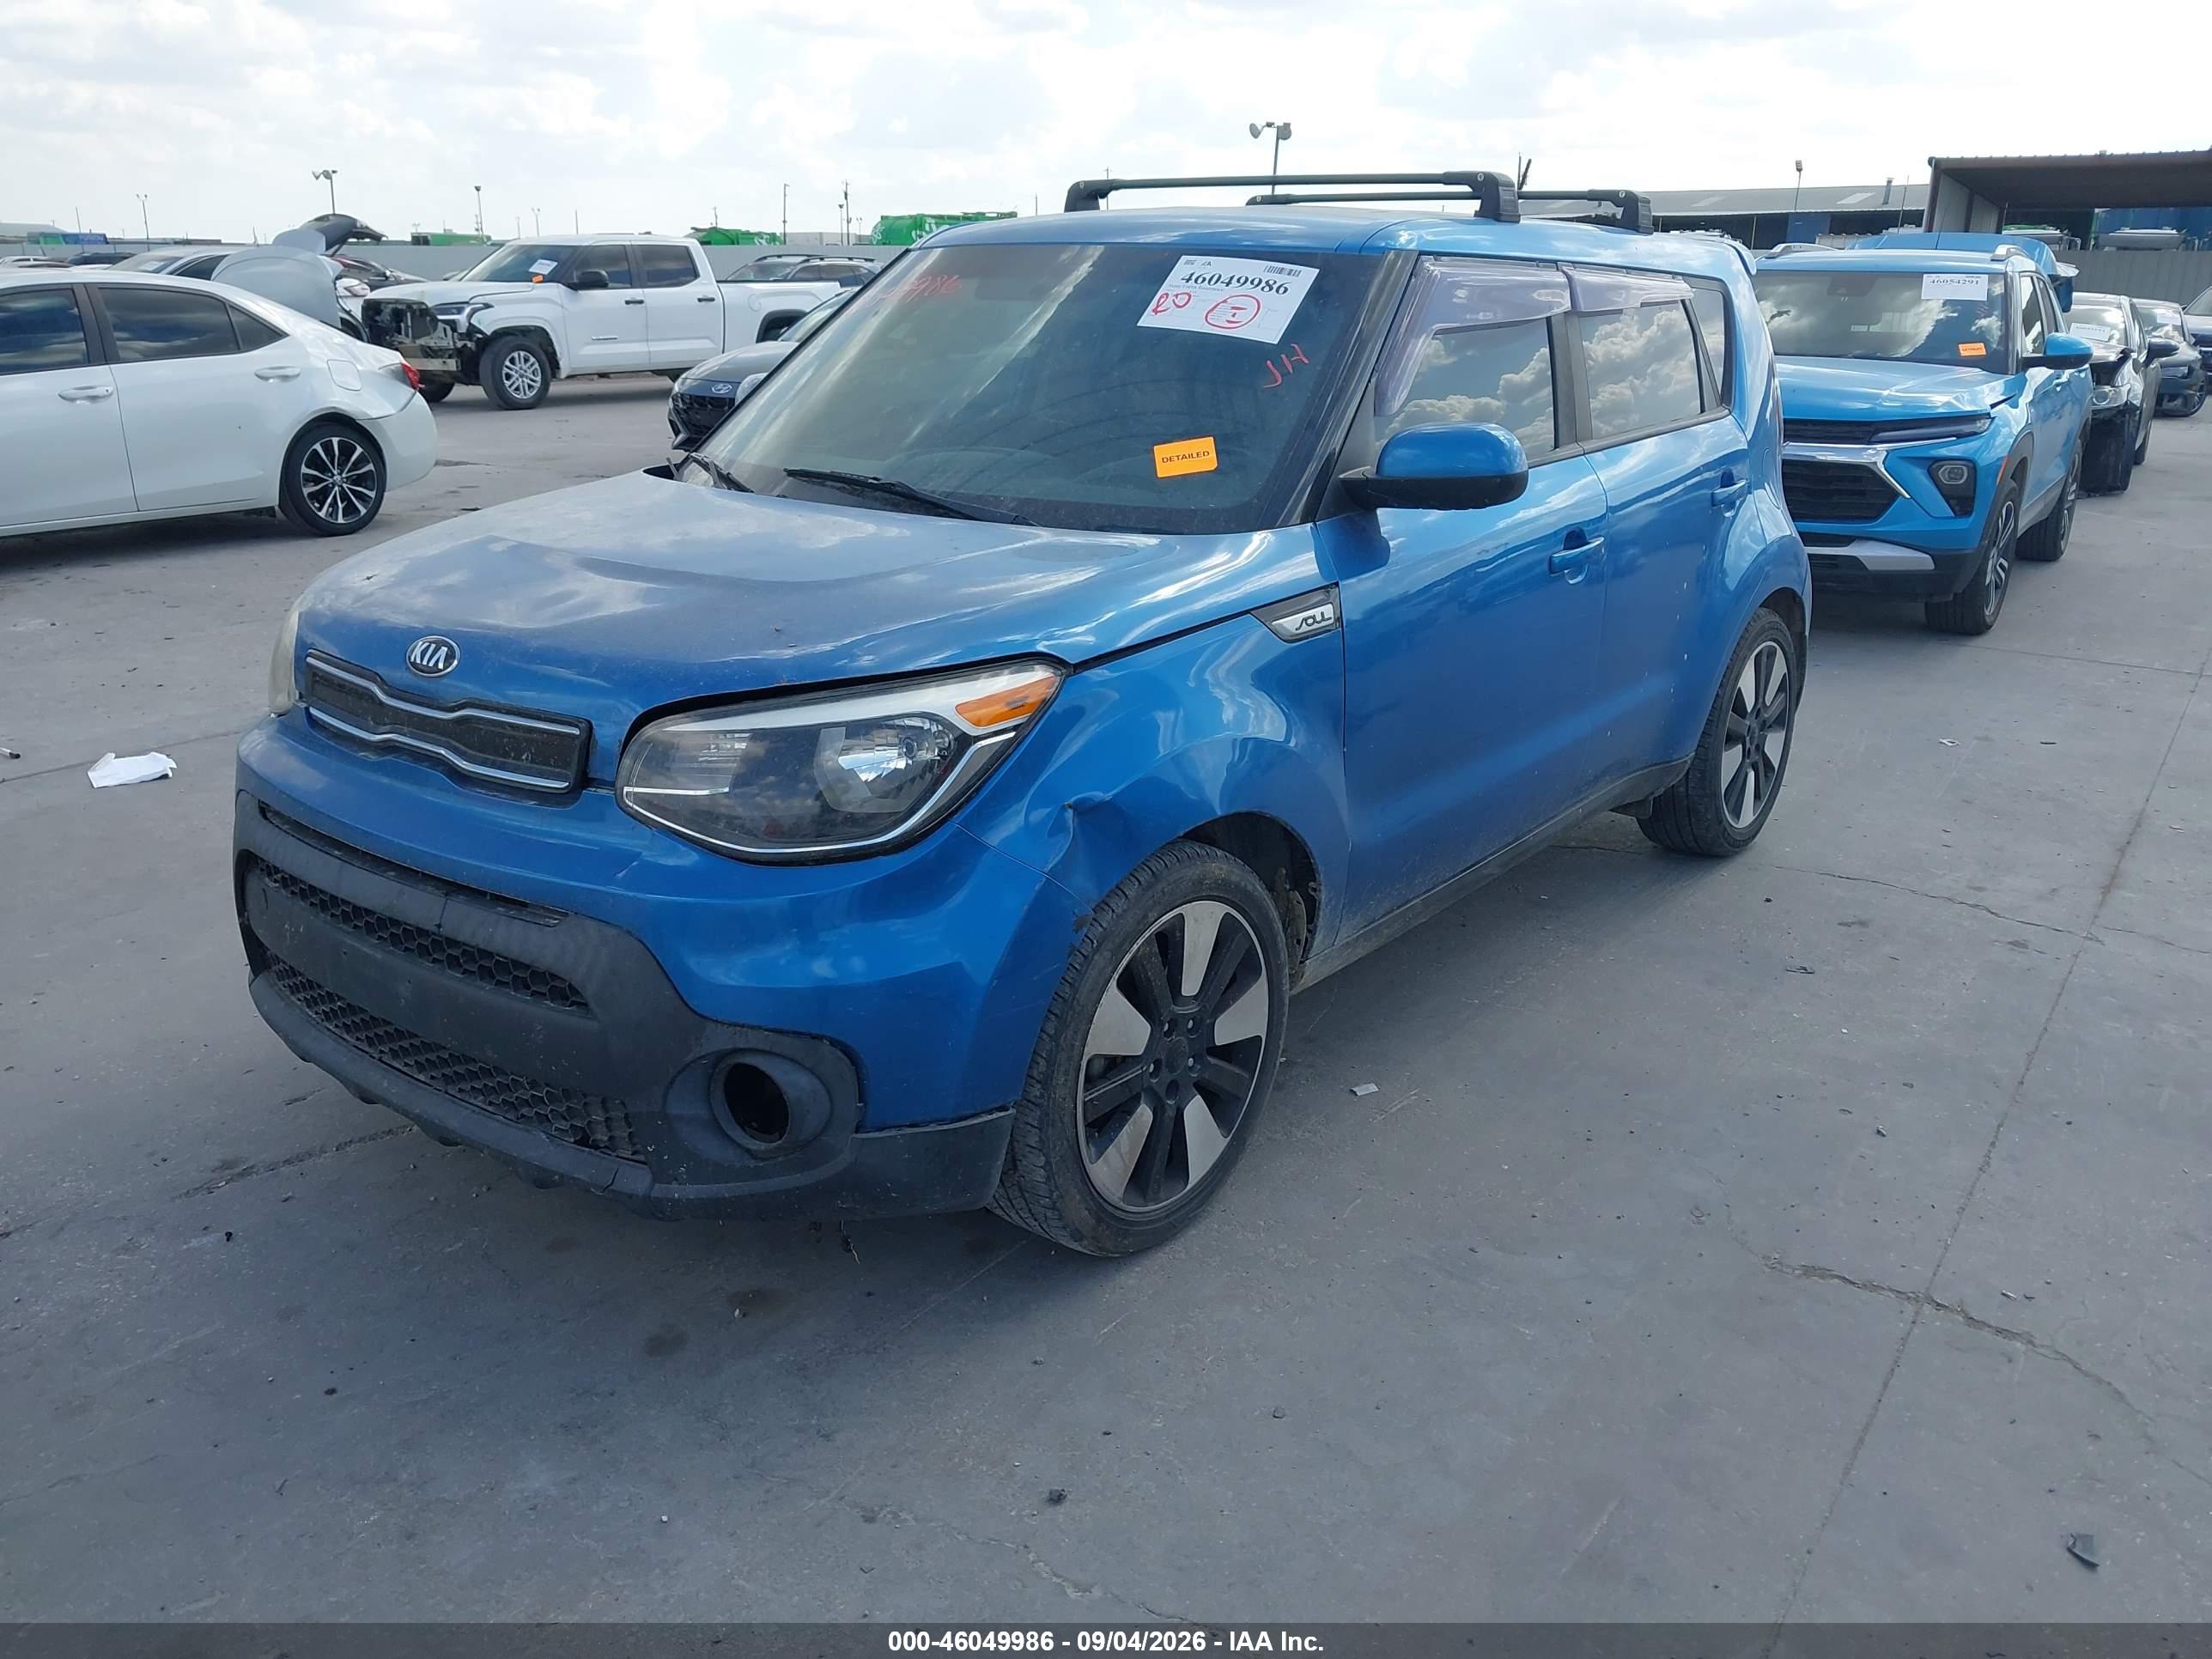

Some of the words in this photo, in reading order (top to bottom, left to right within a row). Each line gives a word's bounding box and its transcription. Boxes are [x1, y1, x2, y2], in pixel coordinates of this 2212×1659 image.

[1180, 271, 1291, 295] 46049986
[1161, 451, 1210, 464] DETAILED
[410, 641, 447, 670] KIA
